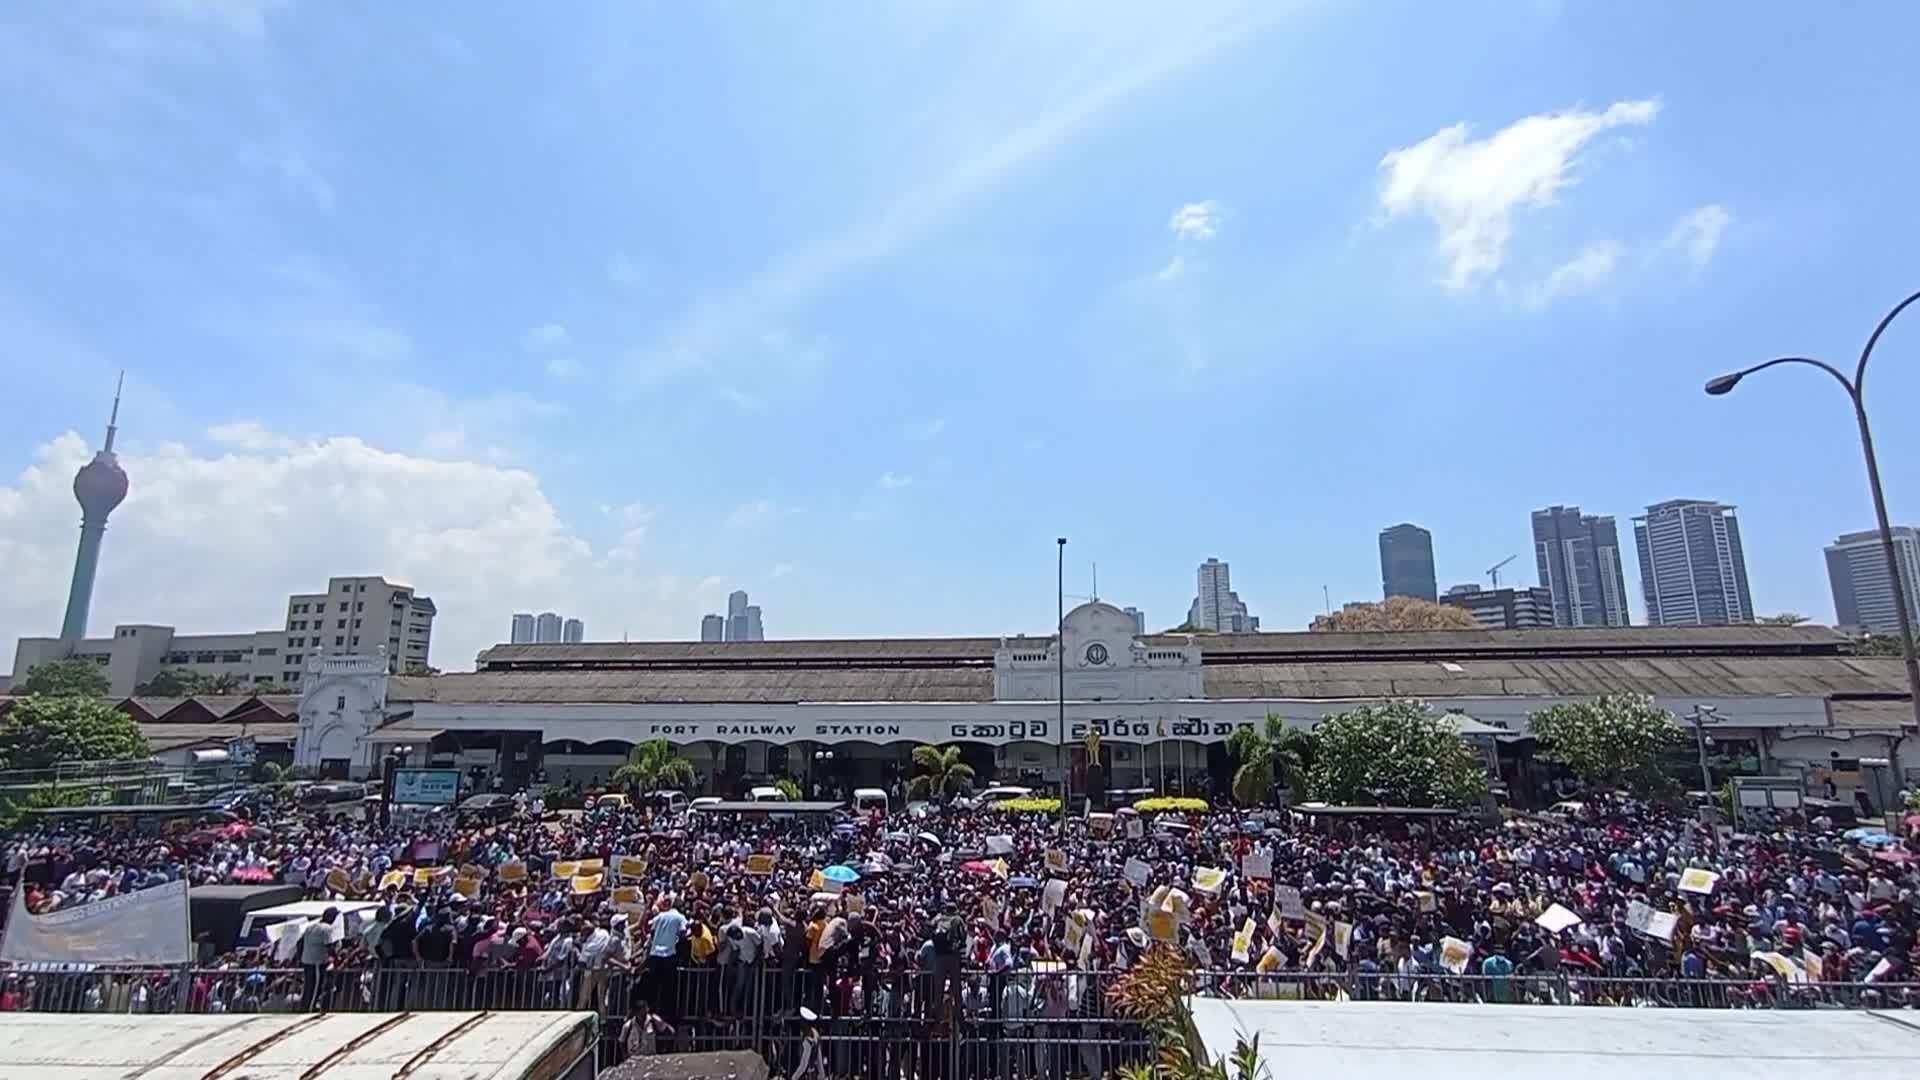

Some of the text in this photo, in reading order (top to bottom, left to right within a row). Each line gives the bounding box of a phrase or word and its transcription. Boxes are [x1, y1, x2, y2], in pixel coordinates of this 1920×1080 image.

[650, 725, 900, 735] FORT RAILWAY STATION
[951, 720, 1047, 739] කොටුව
